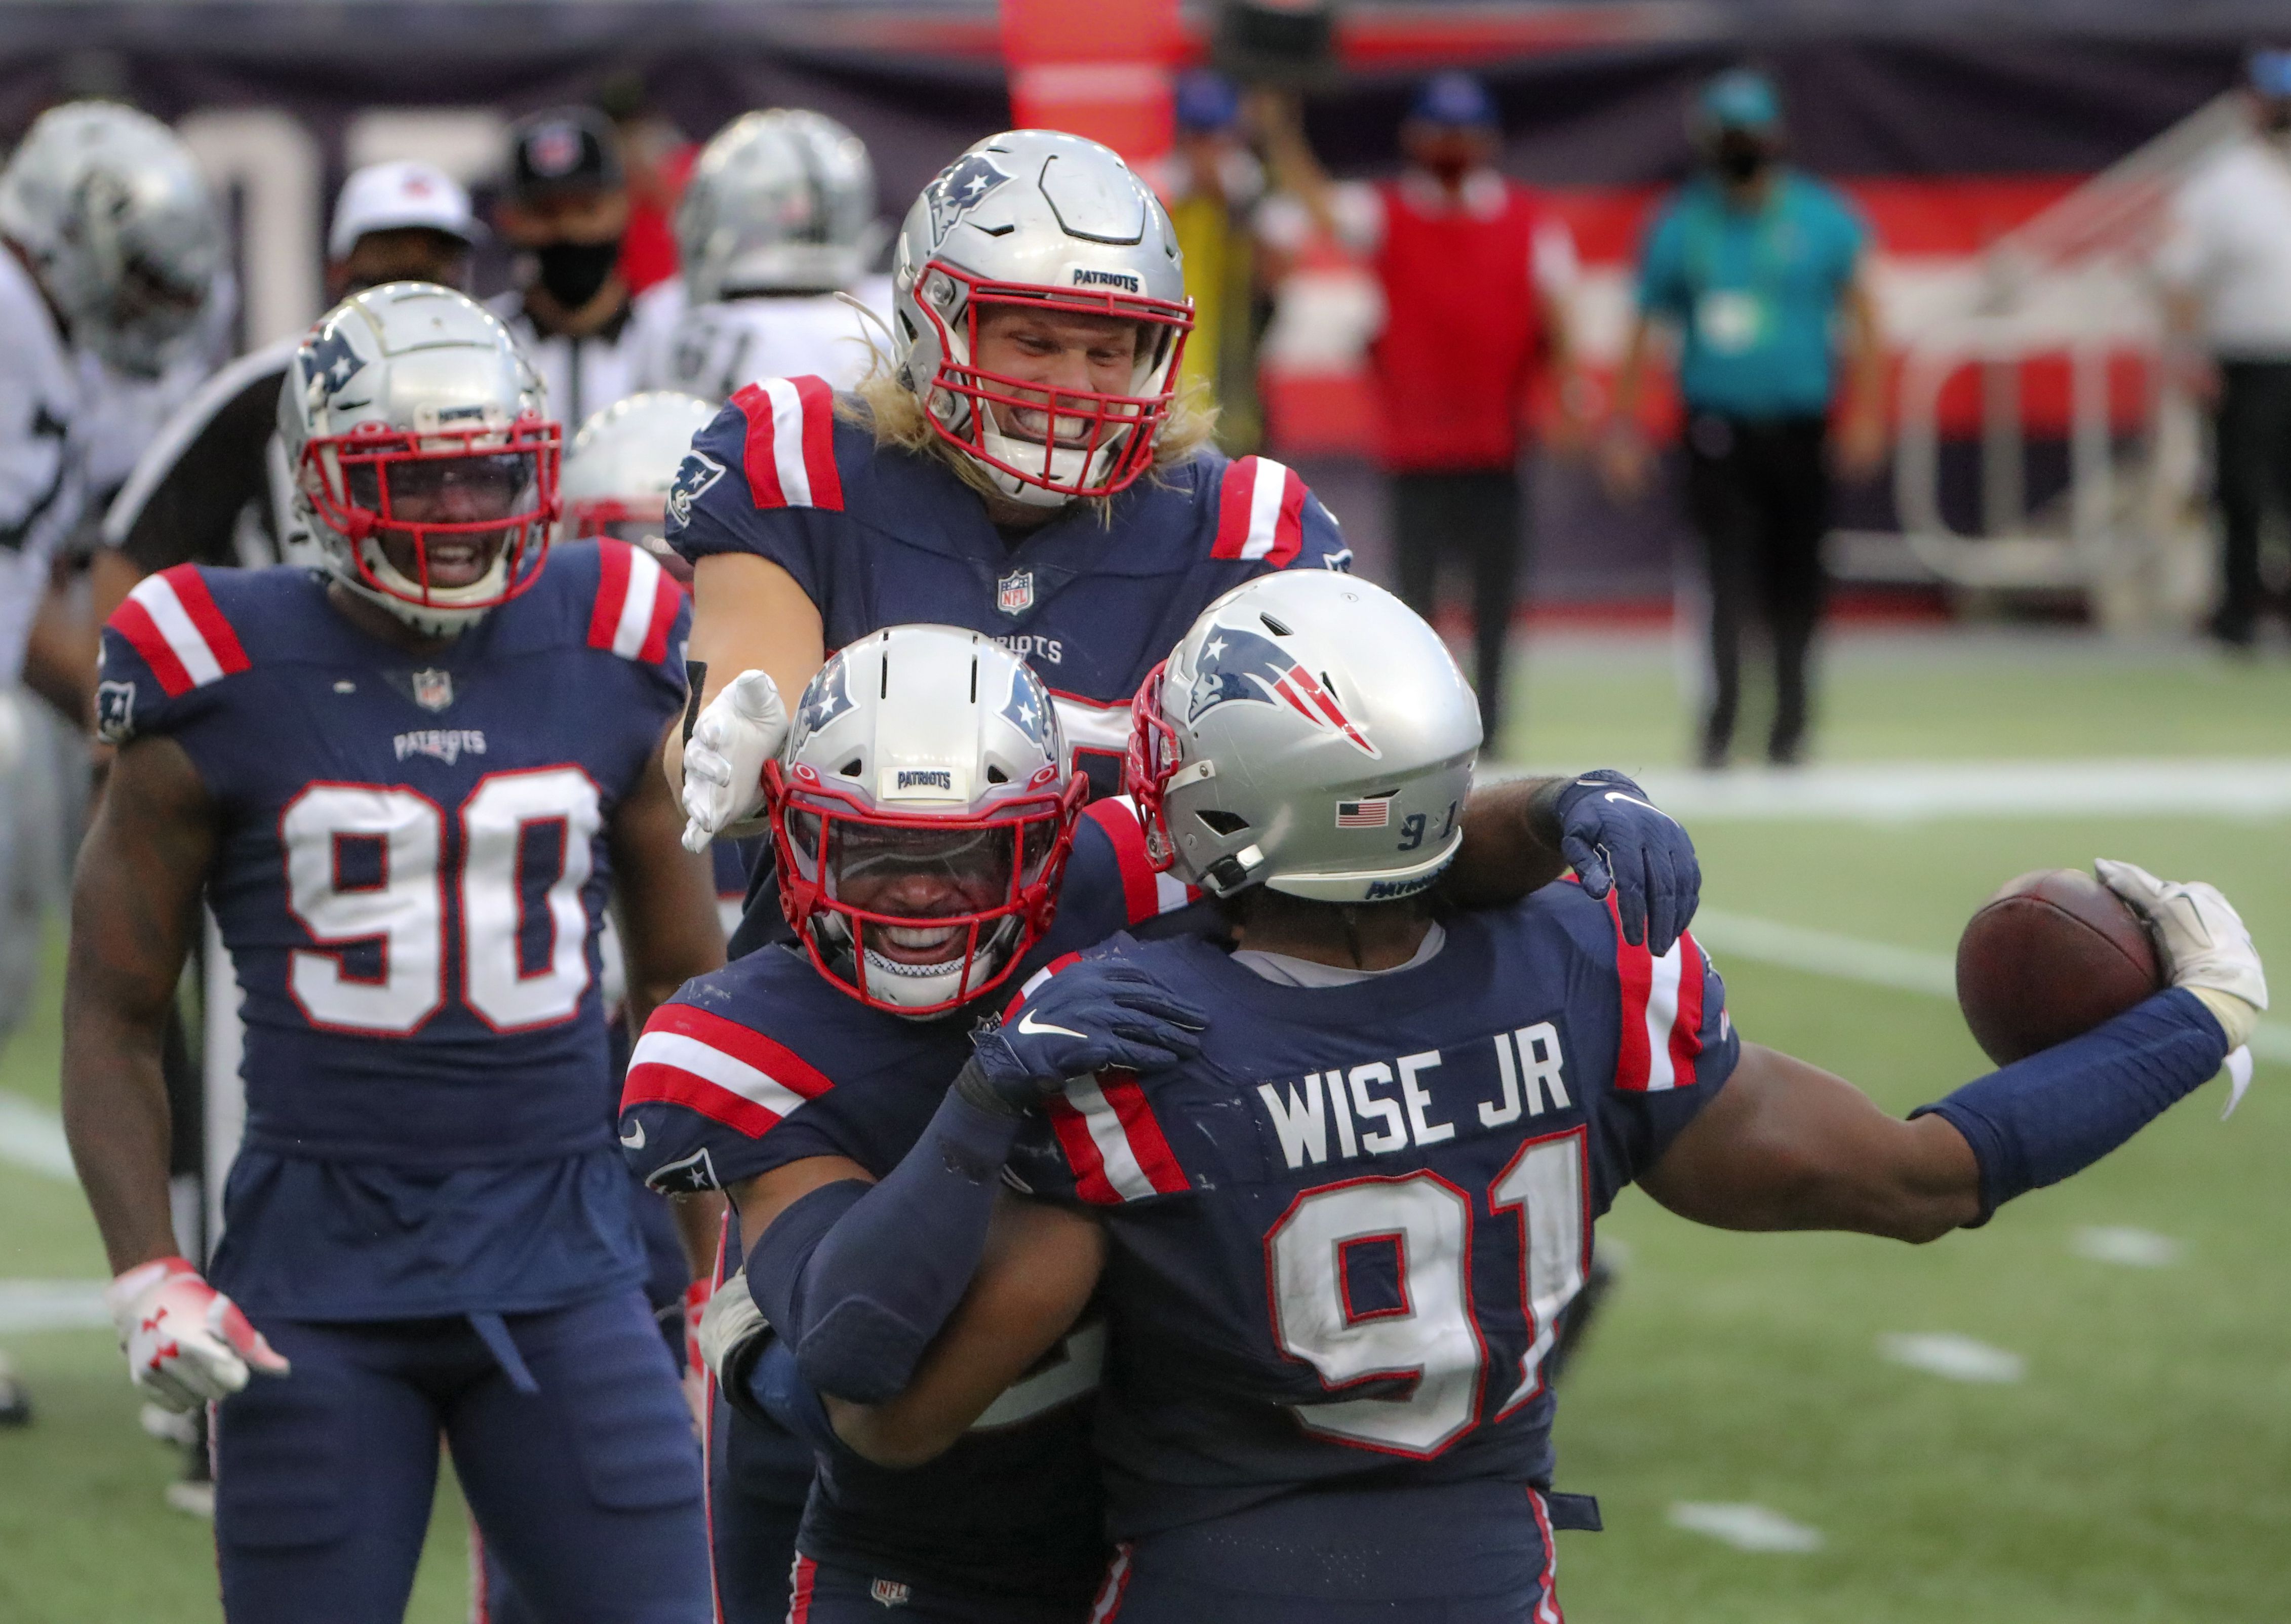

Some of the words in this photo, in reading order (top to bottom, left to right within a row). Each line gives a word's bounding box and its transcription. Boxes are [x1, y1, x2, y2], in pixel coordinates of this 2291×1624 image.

[1073, 268, 1138, 293] PATRIOTS
[1003, 589, 1026, 605] NFL
[898, 771, 951, 789] PATRIOTS
[276, 762, 603, 1038] 90
[1256, 1049, 1455, 1170] WISE
[1477, 1021, 1571, 1128] JR
[1262, 1123, 1591, 1461] 91
[879, 1581, 904, 1597] NFL
